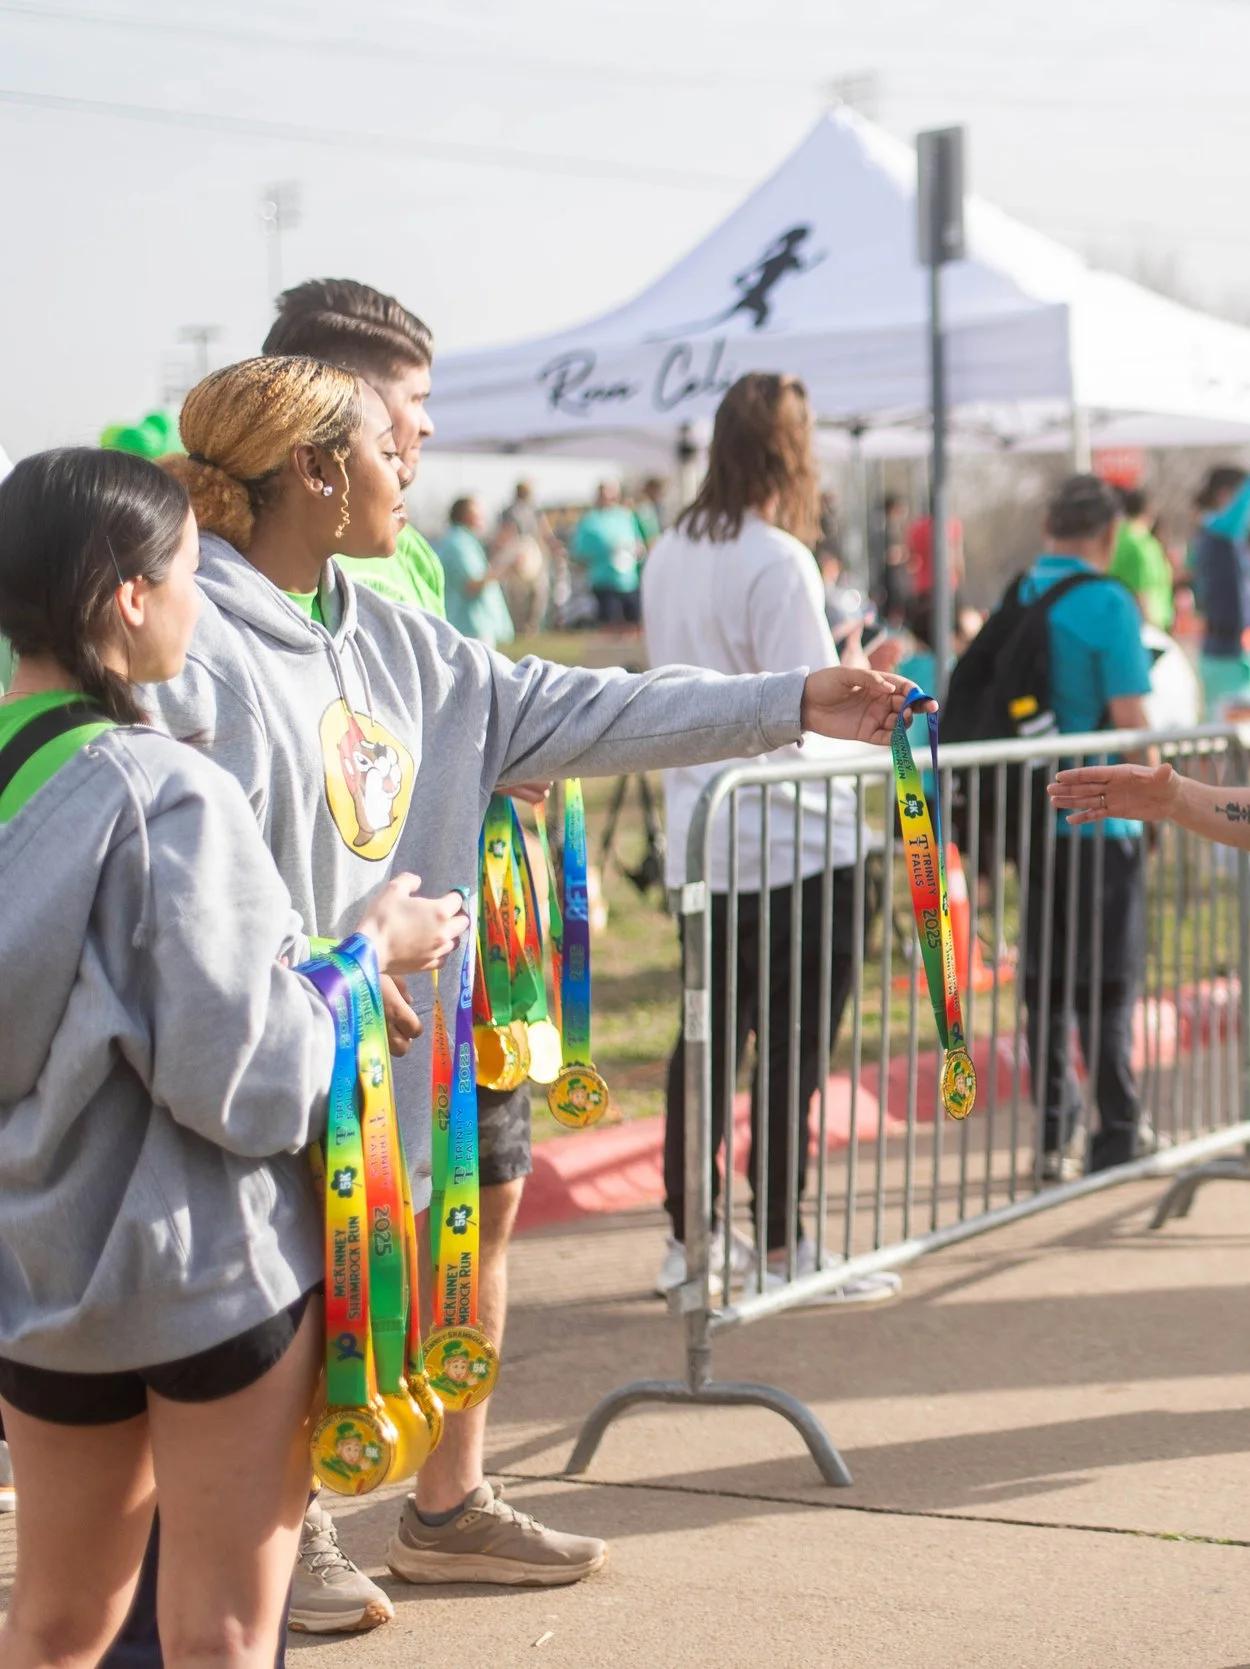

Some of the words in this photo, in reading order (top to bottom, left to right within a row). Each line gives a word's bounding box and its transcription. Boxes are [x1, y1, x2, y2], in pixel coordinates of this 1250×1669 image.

[908, 800, 919, 814] 5K
[911, 853, 924, 887] FALLS
[922, 853, 938, 896] TRINITY
[923, 908, 942, 949] 2025
[458, 1042, 472, 1094] 2025
[438, 1083, 450, 1132] 2025
[455, 1108, 464, 1161] TRINITY
[466, 1121, 474, 1162] FALLS
[340, 1171, 352, 1190] 5K
[347, 1215, 361, 1243] RUN
[373, 1203, 392, 1257] 2025
[454, 1210, 466, 1227] 5K
[347, 1248, 361, 1321] SHAMROCK
[459, 1252, 472, 1278] RUN
[458, 1281, 471, 1325] MROCK
